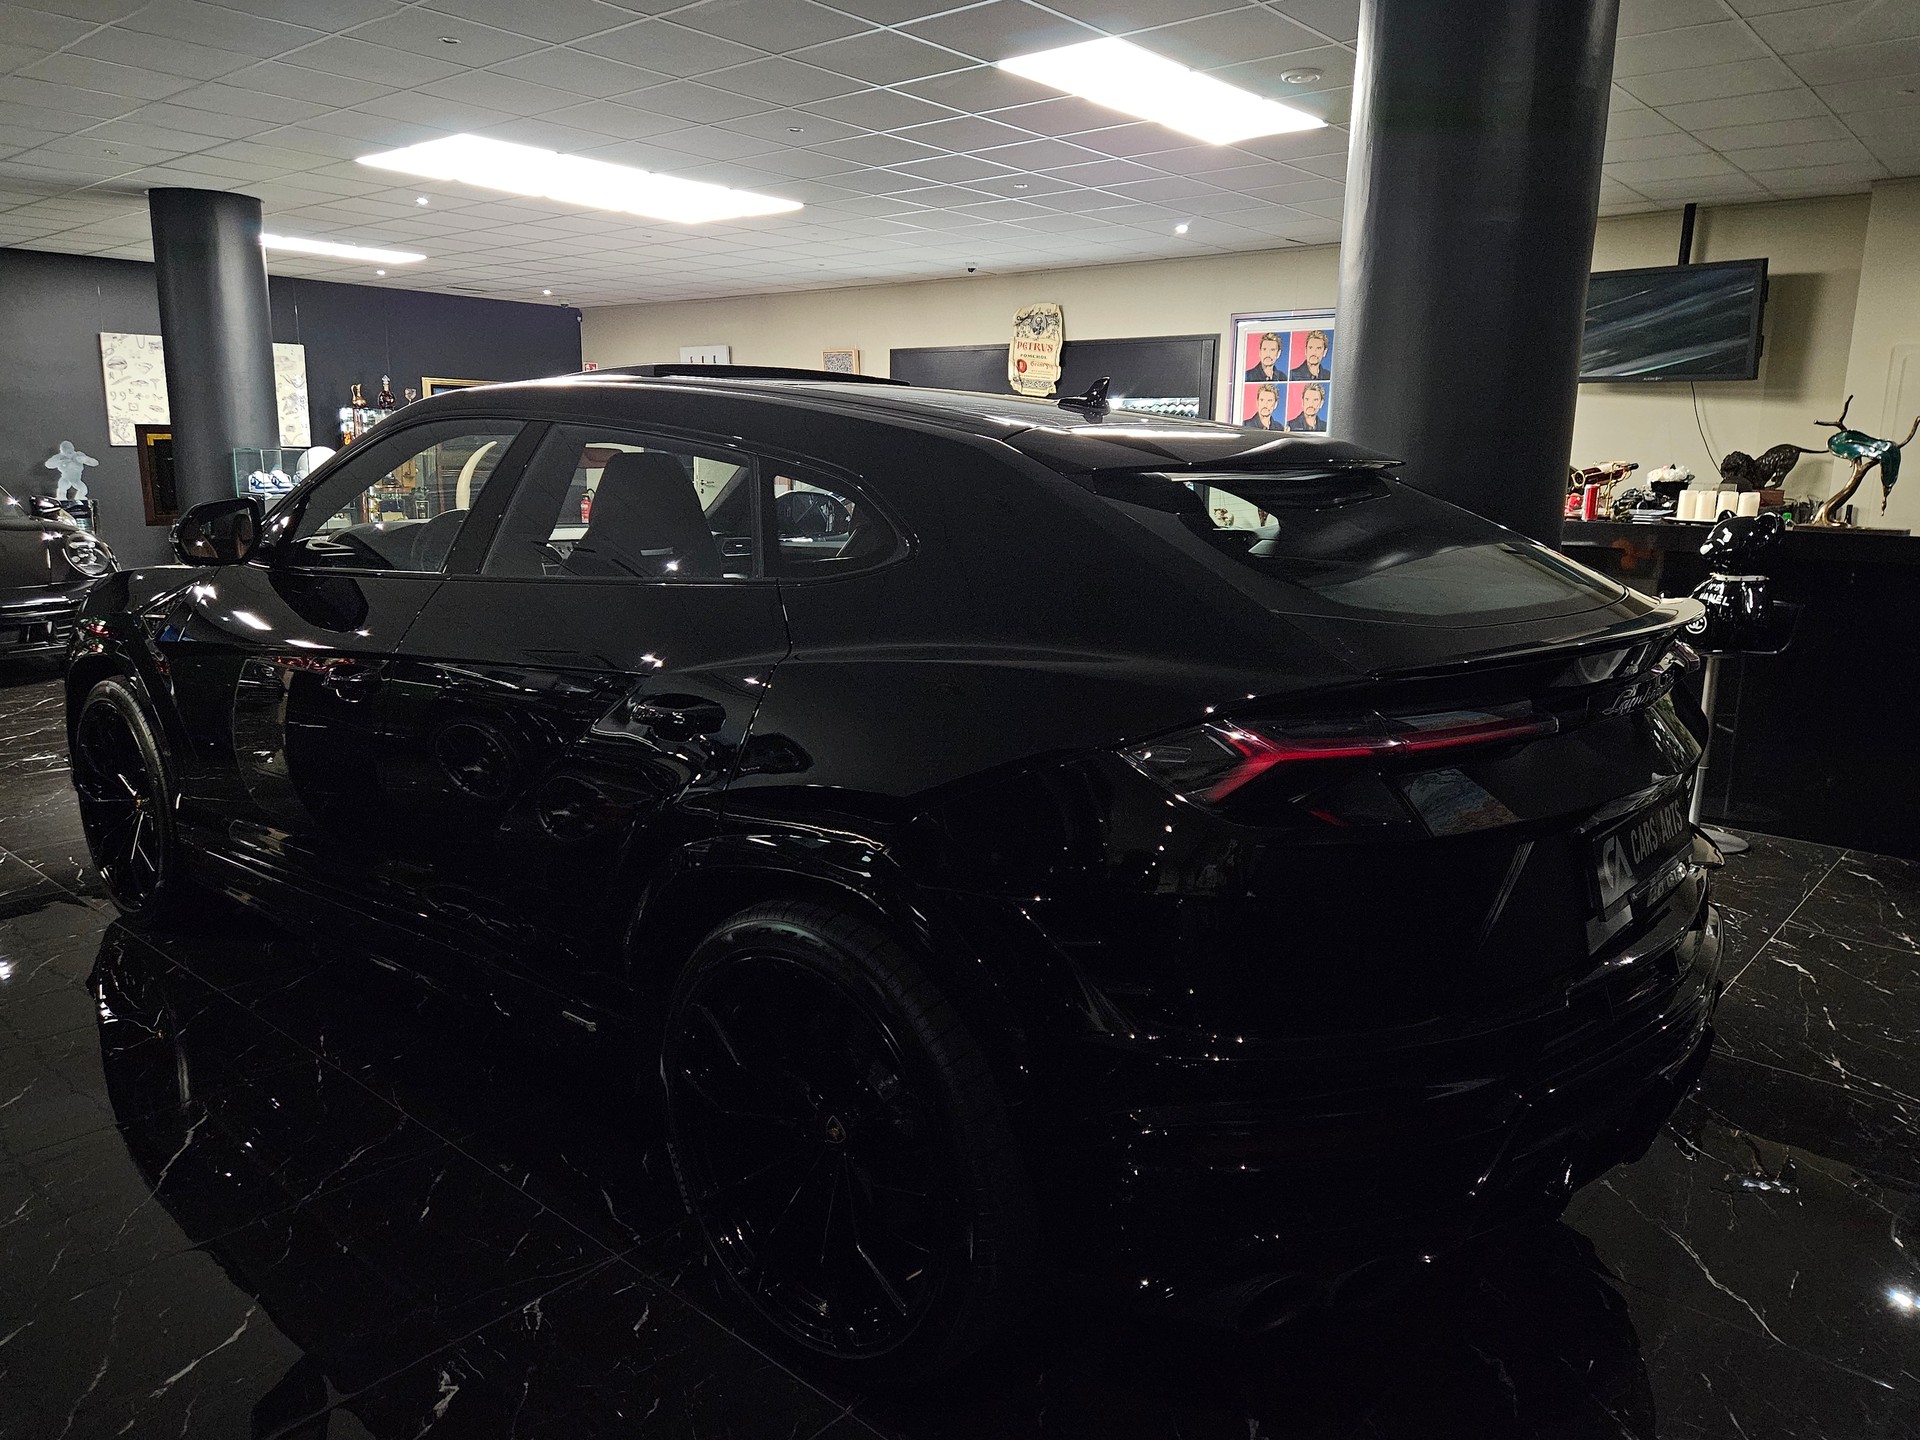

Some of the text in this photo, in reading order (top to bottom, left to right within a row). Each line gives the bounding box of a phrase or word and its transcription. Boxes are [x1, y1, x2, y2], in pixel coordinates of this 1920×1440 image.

[1698, 591, 1730, 606] HANEL
[1629, 799, 1683, 864] CARS ARTS
